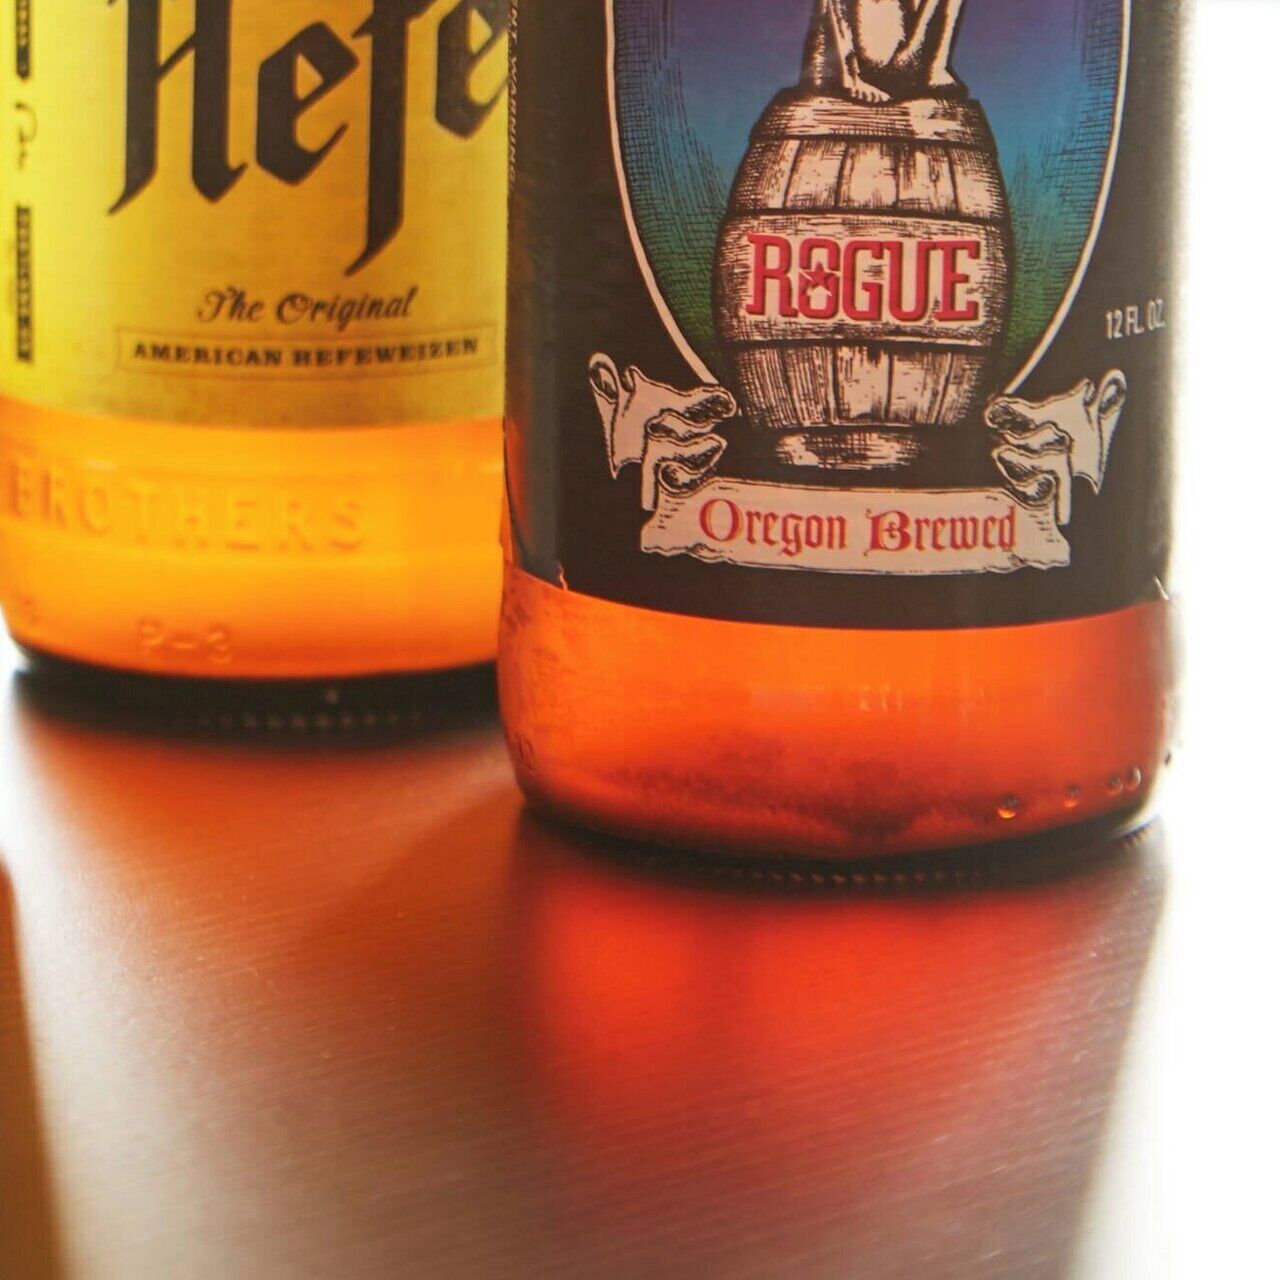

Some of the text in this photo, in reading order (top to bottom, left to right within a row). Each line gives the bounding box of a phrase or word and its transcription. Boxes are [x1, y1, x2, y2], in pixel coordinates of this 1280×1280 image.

[743, 233, 982, 324] ROGUE
[196, 284, 419, 332] The Original
[1105, 308, 1123, 340] 12
[133, 336, 479, 367] AMERICAN HEFEWEIZEN
[699, 497, 1017, 557] Oregon Brewed
